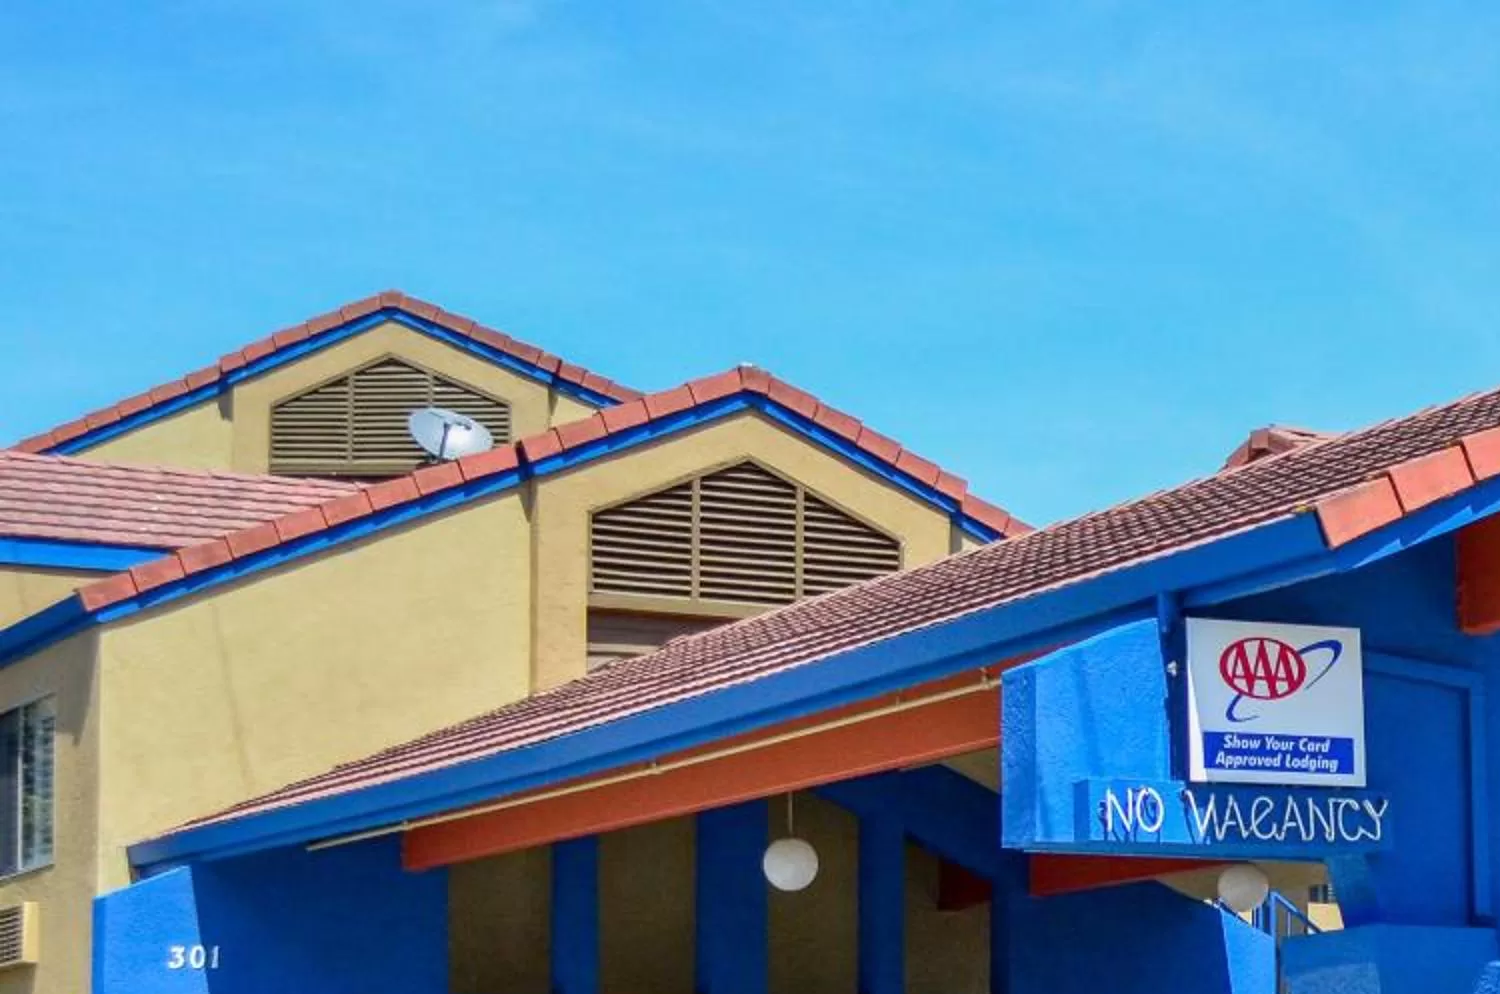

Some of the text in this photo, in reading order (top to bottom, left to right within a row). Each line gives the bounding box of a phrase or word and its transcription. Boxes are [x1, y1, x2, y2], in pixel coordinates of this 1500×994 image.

[1222, 638, 1303, 699] AAA
[1223, 734, 1331, 753] Show Your Card
[1215, 751, 1339, 773] Approved Lodging
[1104, 786, 1389, 842] NO VACANCY
[168, 944, 220, 969] 301
